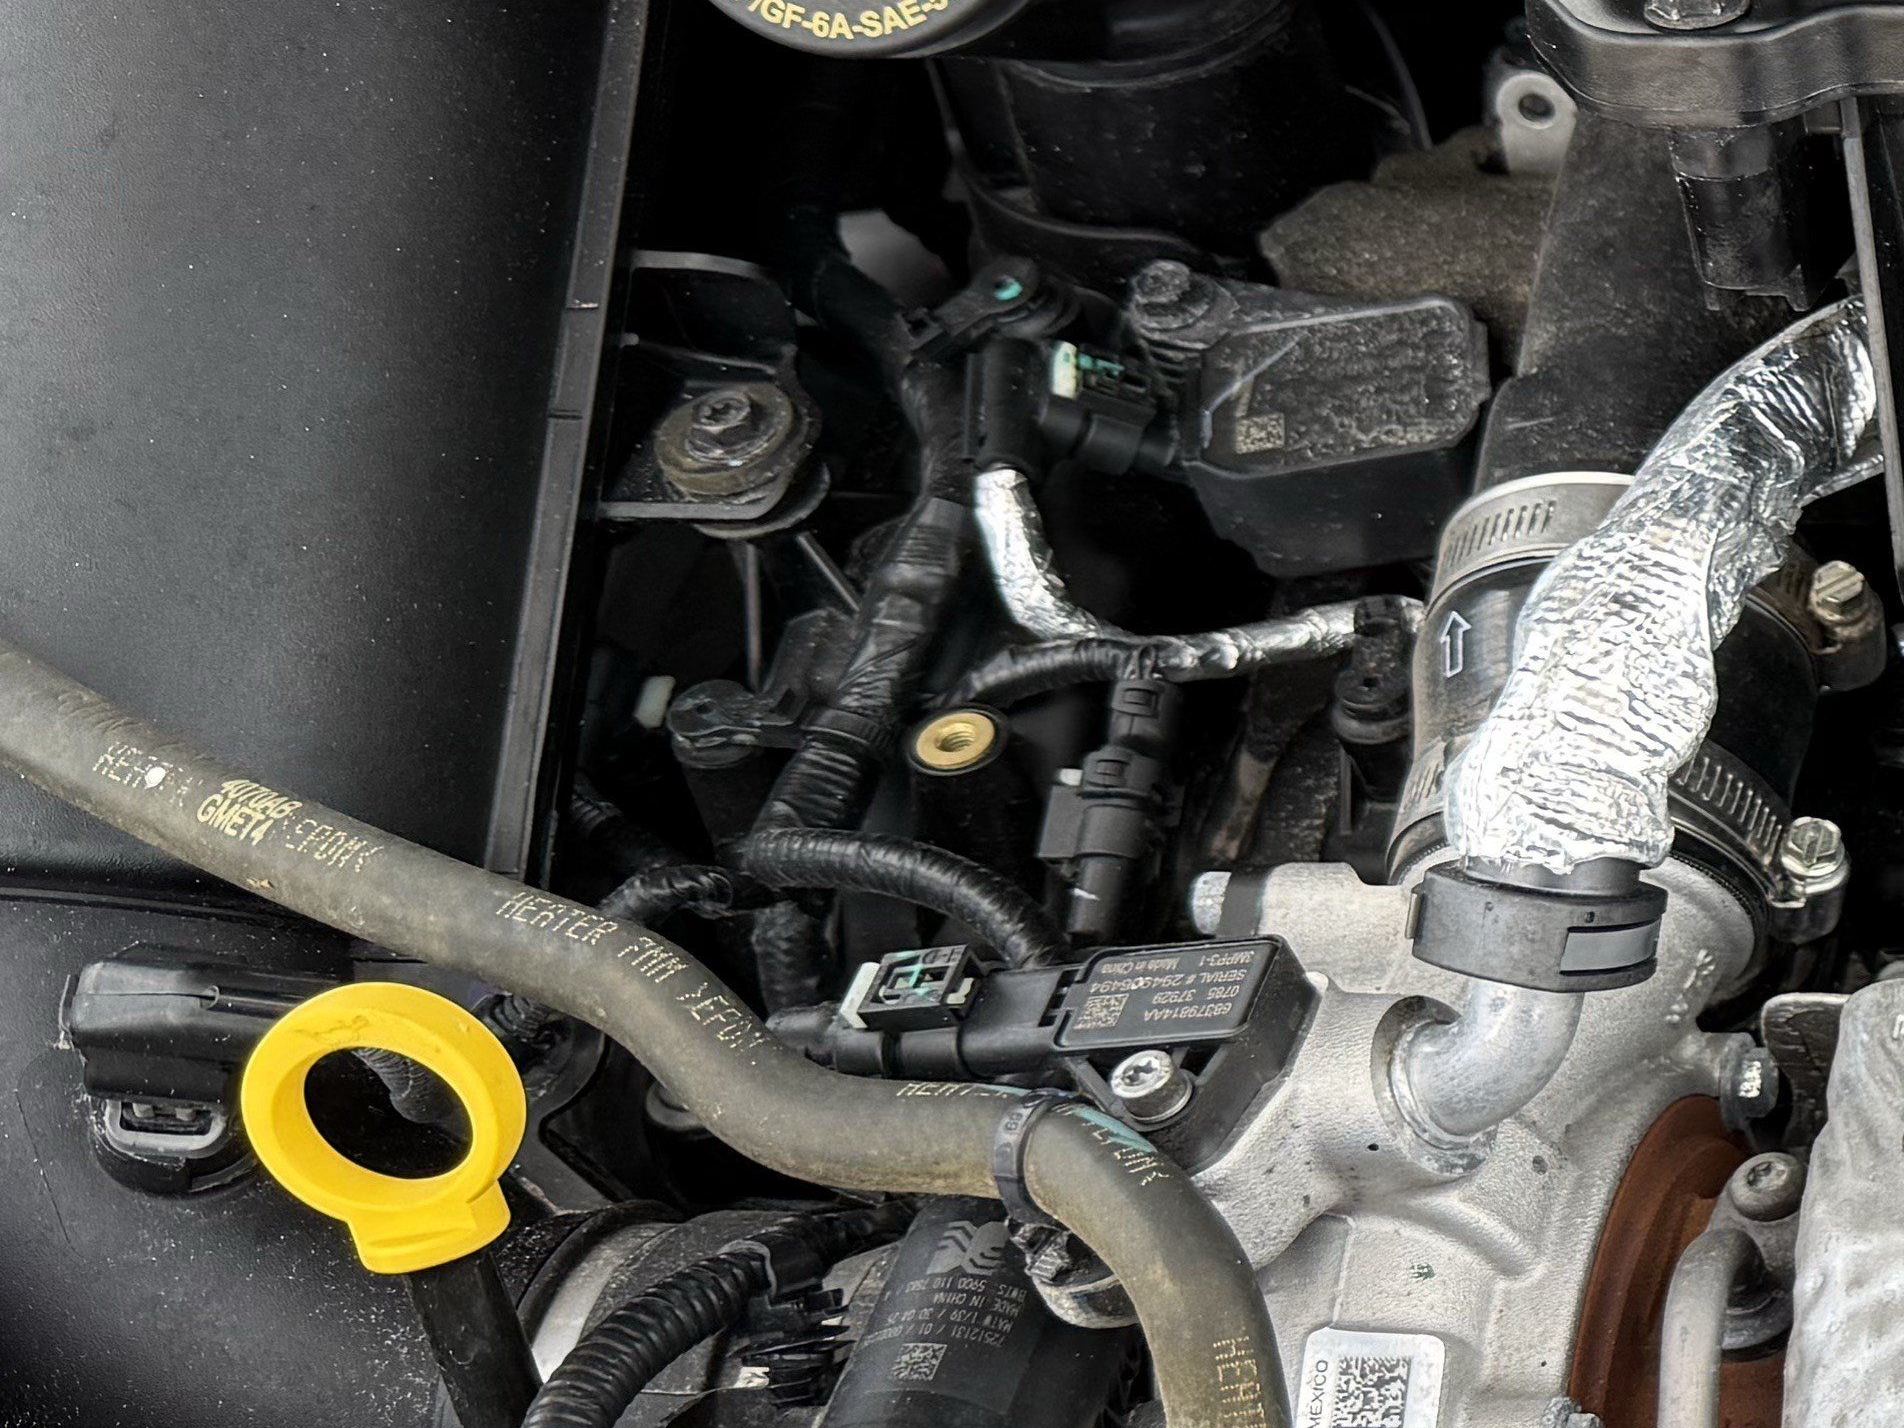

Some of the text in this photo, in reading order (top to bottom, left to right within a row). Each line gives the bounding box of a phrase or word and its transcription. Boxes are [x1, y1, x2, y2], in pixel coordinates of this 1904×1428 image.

[495, 891, 619, 946] HEATER
[1101, 961, 1134, 975] China
[1136, 961, 1146, 971] in
[1148, 957, 1181, 971] Made
[1198, 969, 1247, 983] SERIAL
[969, 1296, 986, 1307] IN
